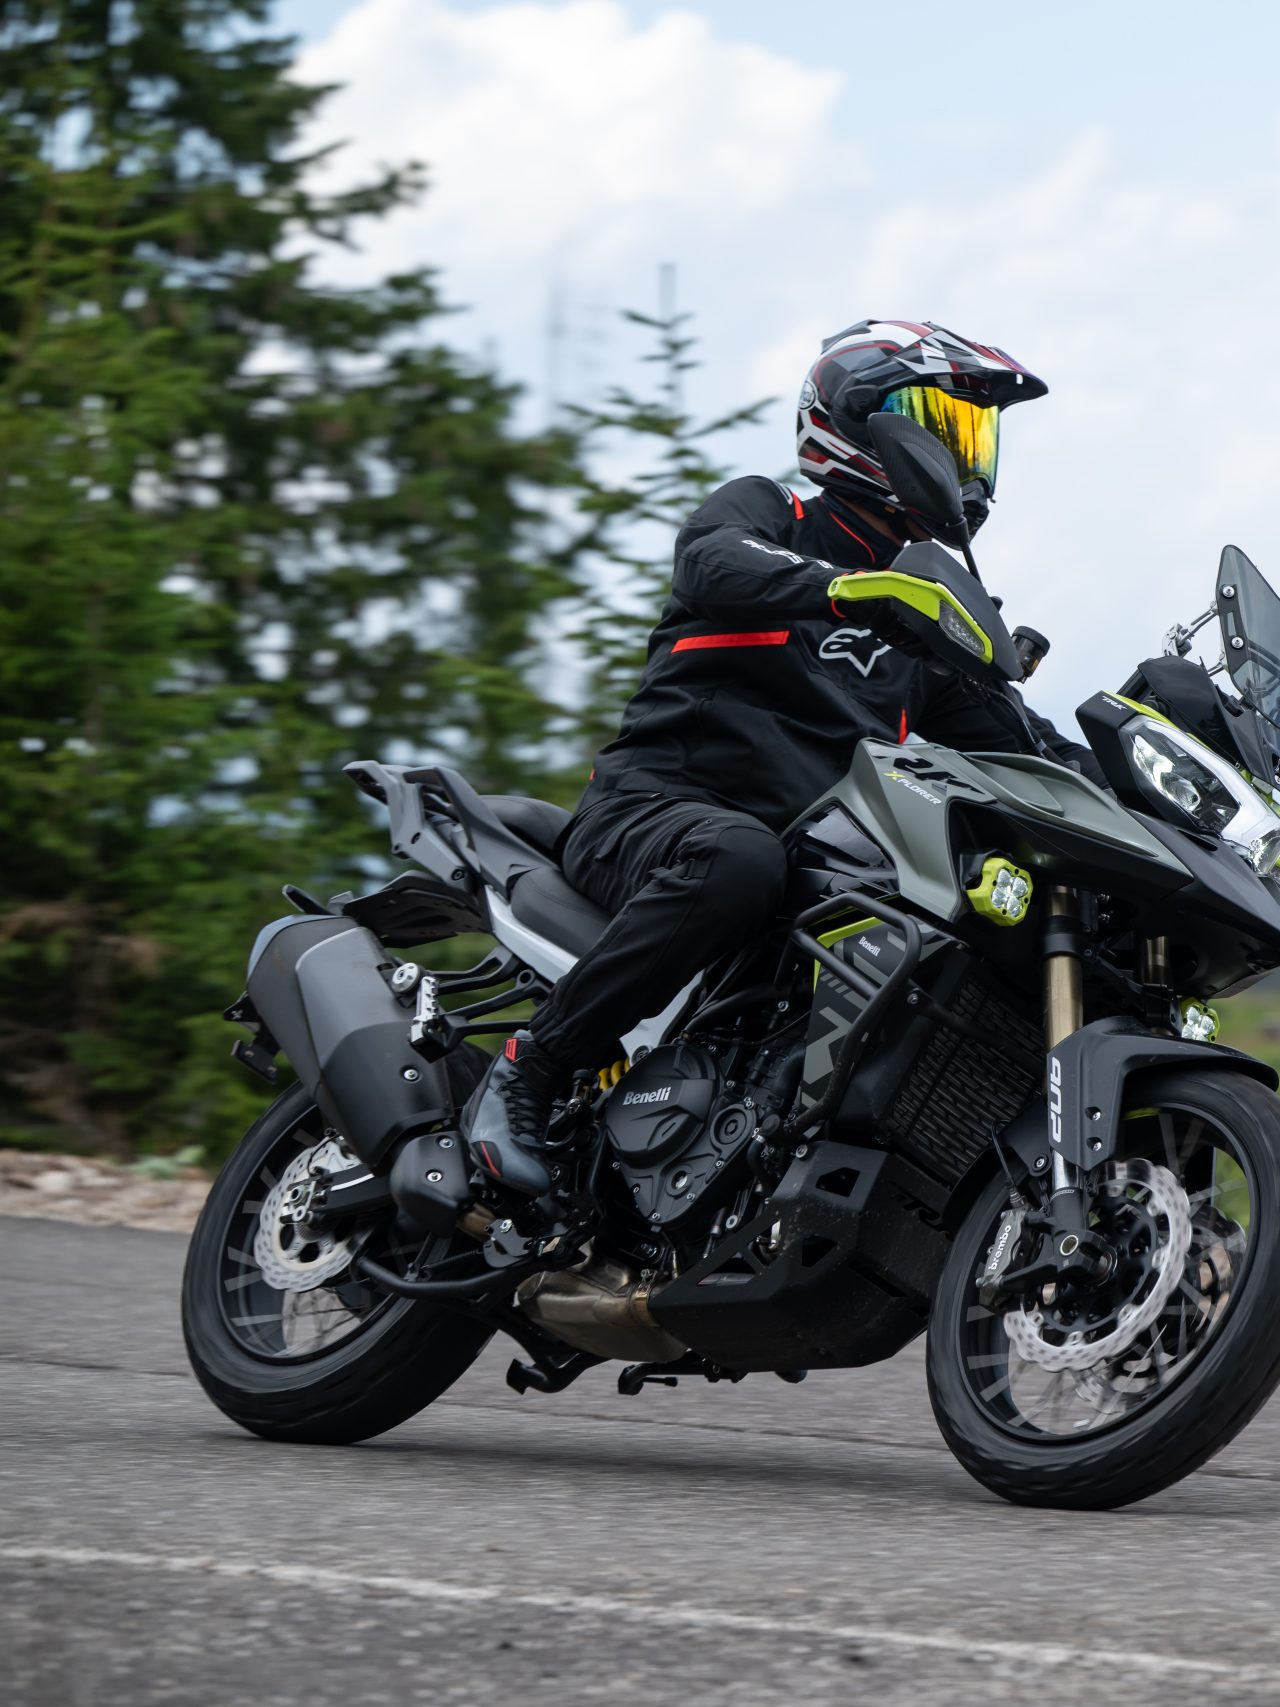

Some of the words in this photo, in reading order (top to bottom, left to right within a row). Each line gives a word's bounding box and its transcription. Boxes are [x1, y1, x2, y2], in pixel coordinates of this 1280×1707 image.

[1101, 695, 1127, 710] TRK
[883, 770, 942, 805] XPLORER
[858, 936, 881, 957] Benelli
[622, 1086, 672, 1106] Benelli
[988, 1224, 1012, 1270] brembo
